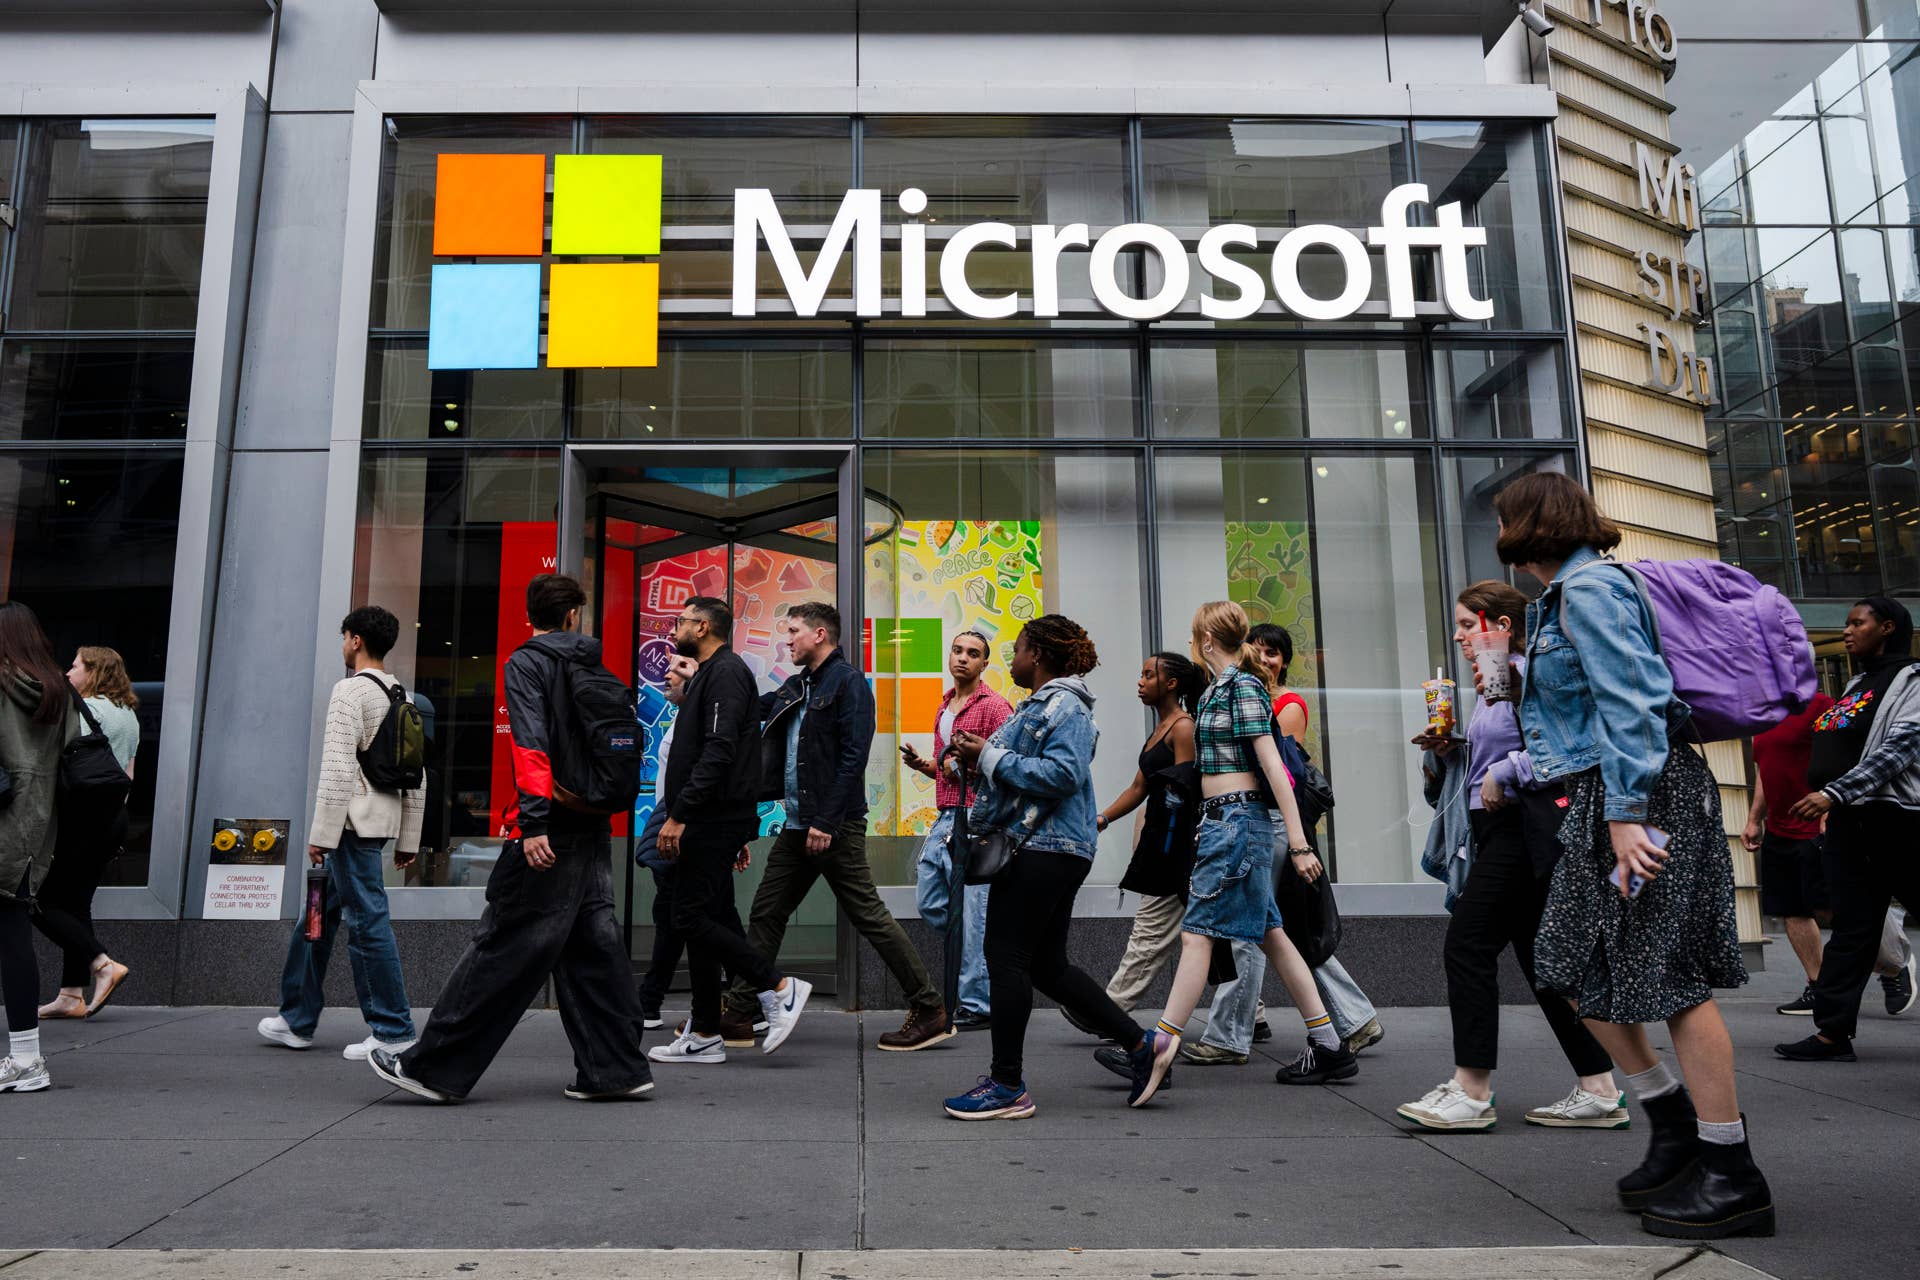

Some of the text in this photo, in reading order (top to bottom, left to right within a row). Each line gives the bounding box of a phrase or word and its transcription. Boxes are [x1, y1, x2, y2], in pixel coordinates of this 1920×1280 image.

[731, 182, 1495, 321] Microsoft
[650, 580, 660, 607] HTML
[643, 647, 671, 673] .NE
[645, 662, 660, 676] Core
[210, 892, 246, 900] CONNECTION
